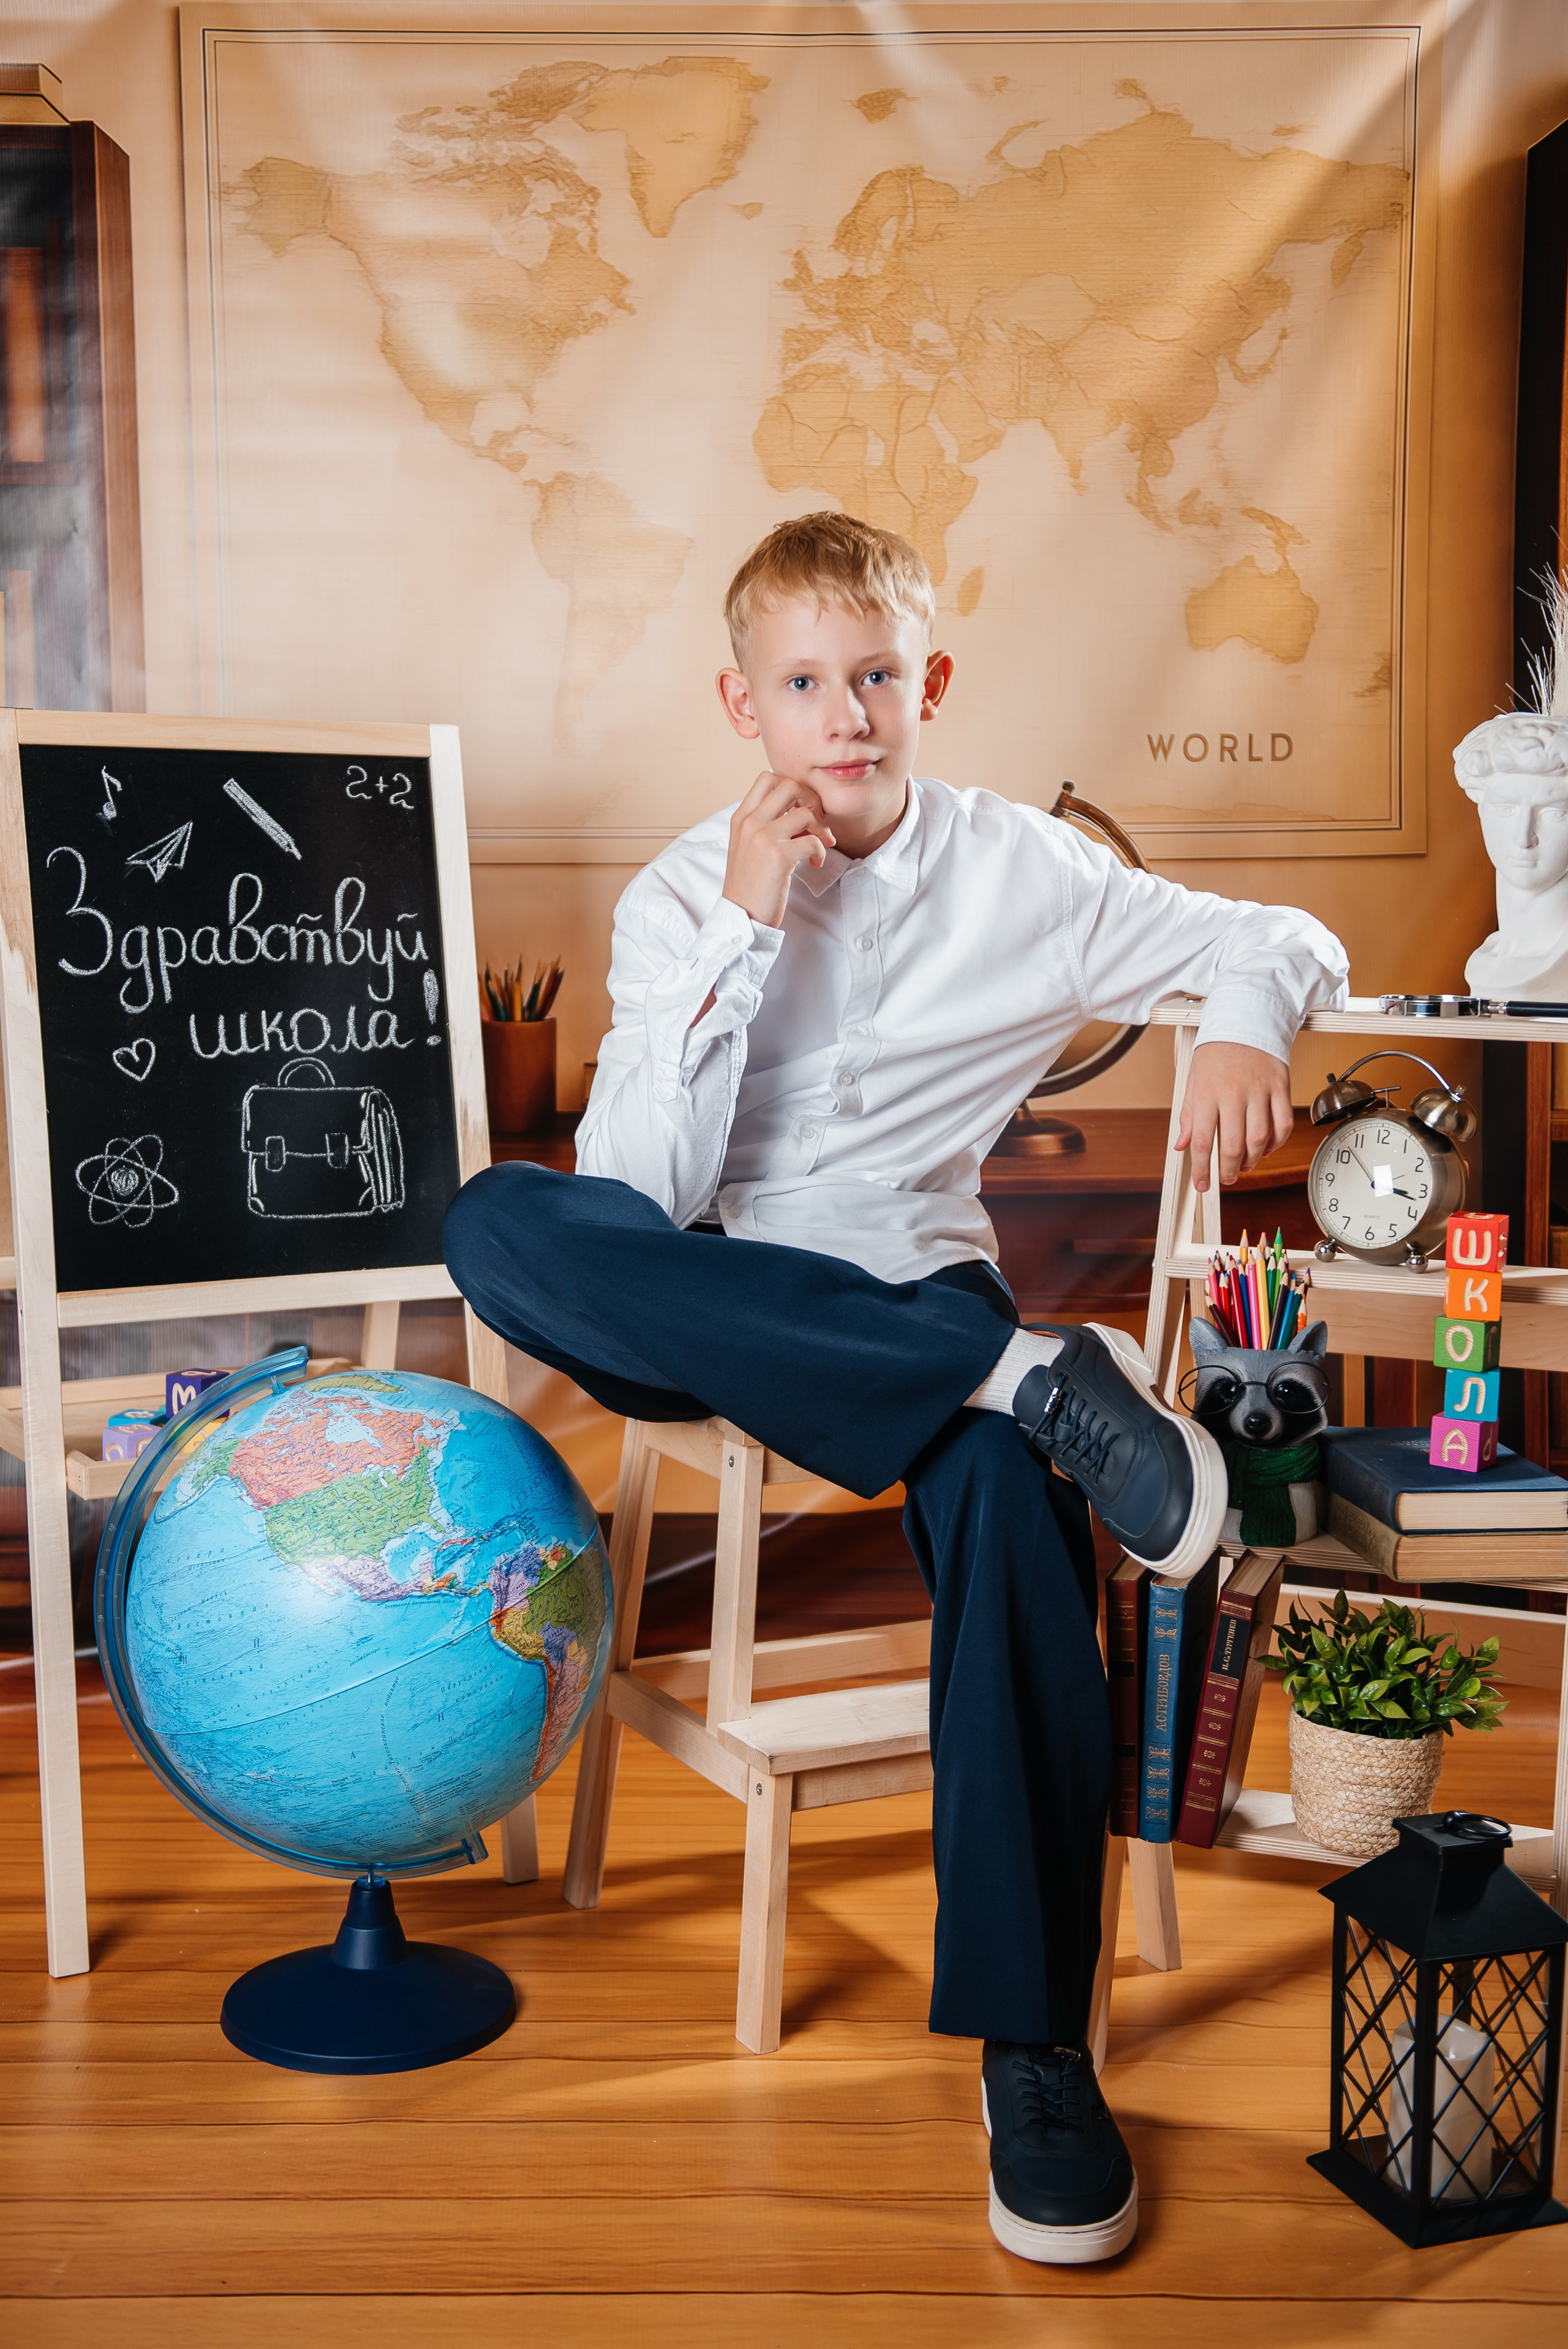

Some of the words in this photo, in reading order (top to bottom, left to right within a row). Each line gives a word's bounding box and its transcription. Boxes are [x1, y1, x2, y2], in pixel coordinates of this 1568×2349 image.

[1146, 733, 1294, 763] WORLD
[346, 765, 414, 809] 2+2
[47, 846, 429, 1013] Здравствуй
[1354, 1134, 1364, 1148] 11
[1377, 1129, 1390, 1144] 12
[1403, 1139, 1408, 1153] 1
[1336, 1149, 1351, 1164] 10
[1415, 1158, 1423, 1172] 2
[1325, 1173, 1335, 1187] 9
[1419, 1183, 1428, 1198] 3
[1329, 1198, 1338, 1212] 8
[1408, 1206, 1417, 1221] 4
[1342, 1216, 1351, 1230] 7
[1365, 1226, 1374, 1240] 6
[1388, 1224, 1397, 1238] 5
[1224, 1619, 1237, 1655] ТУРГЕНЕВ
